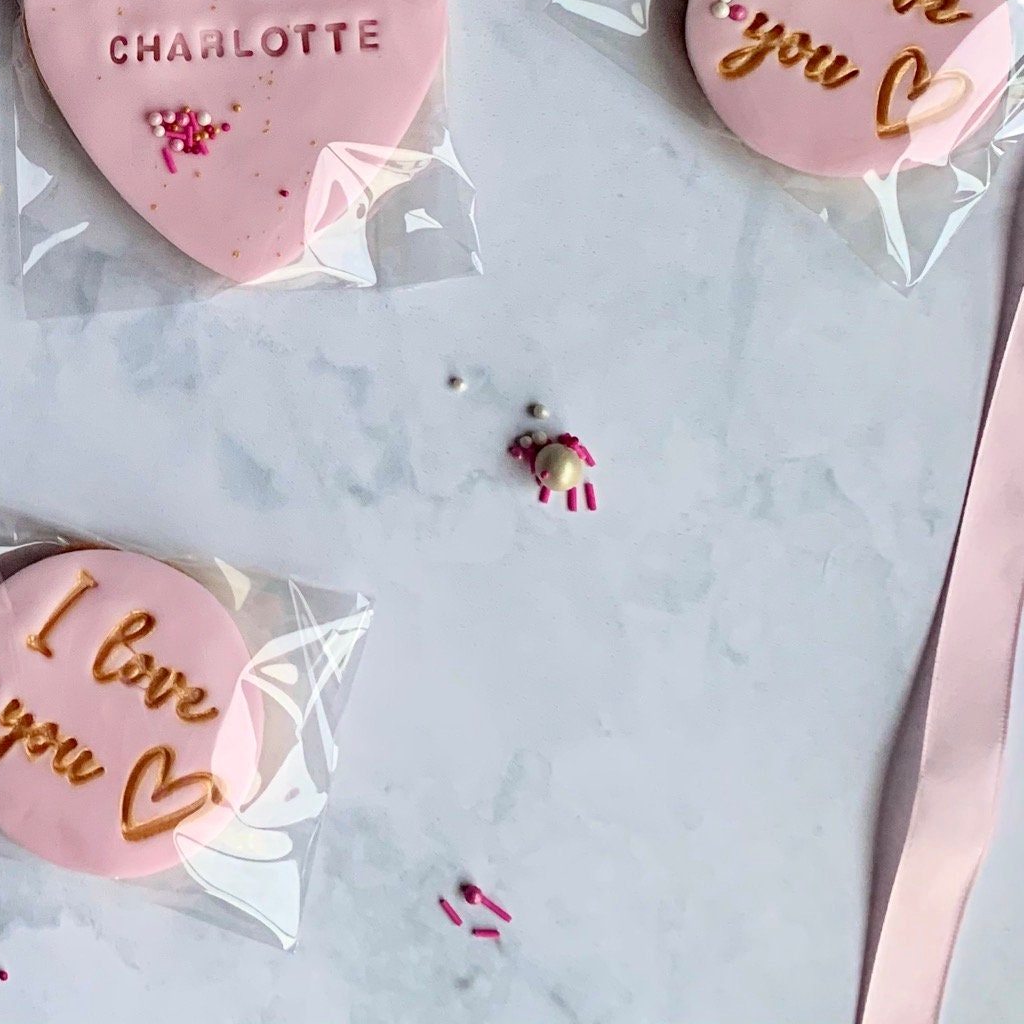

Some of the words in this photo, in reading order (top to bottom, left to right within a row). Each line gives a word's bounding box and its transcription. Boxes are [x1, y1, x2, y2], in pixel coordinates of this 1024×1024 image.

[109, 19, 380, 65] CHARLOTTE
[717, 11, 860, 89] you
[26, 568, 98, 658] I
[92, 609, 220, 723] love
